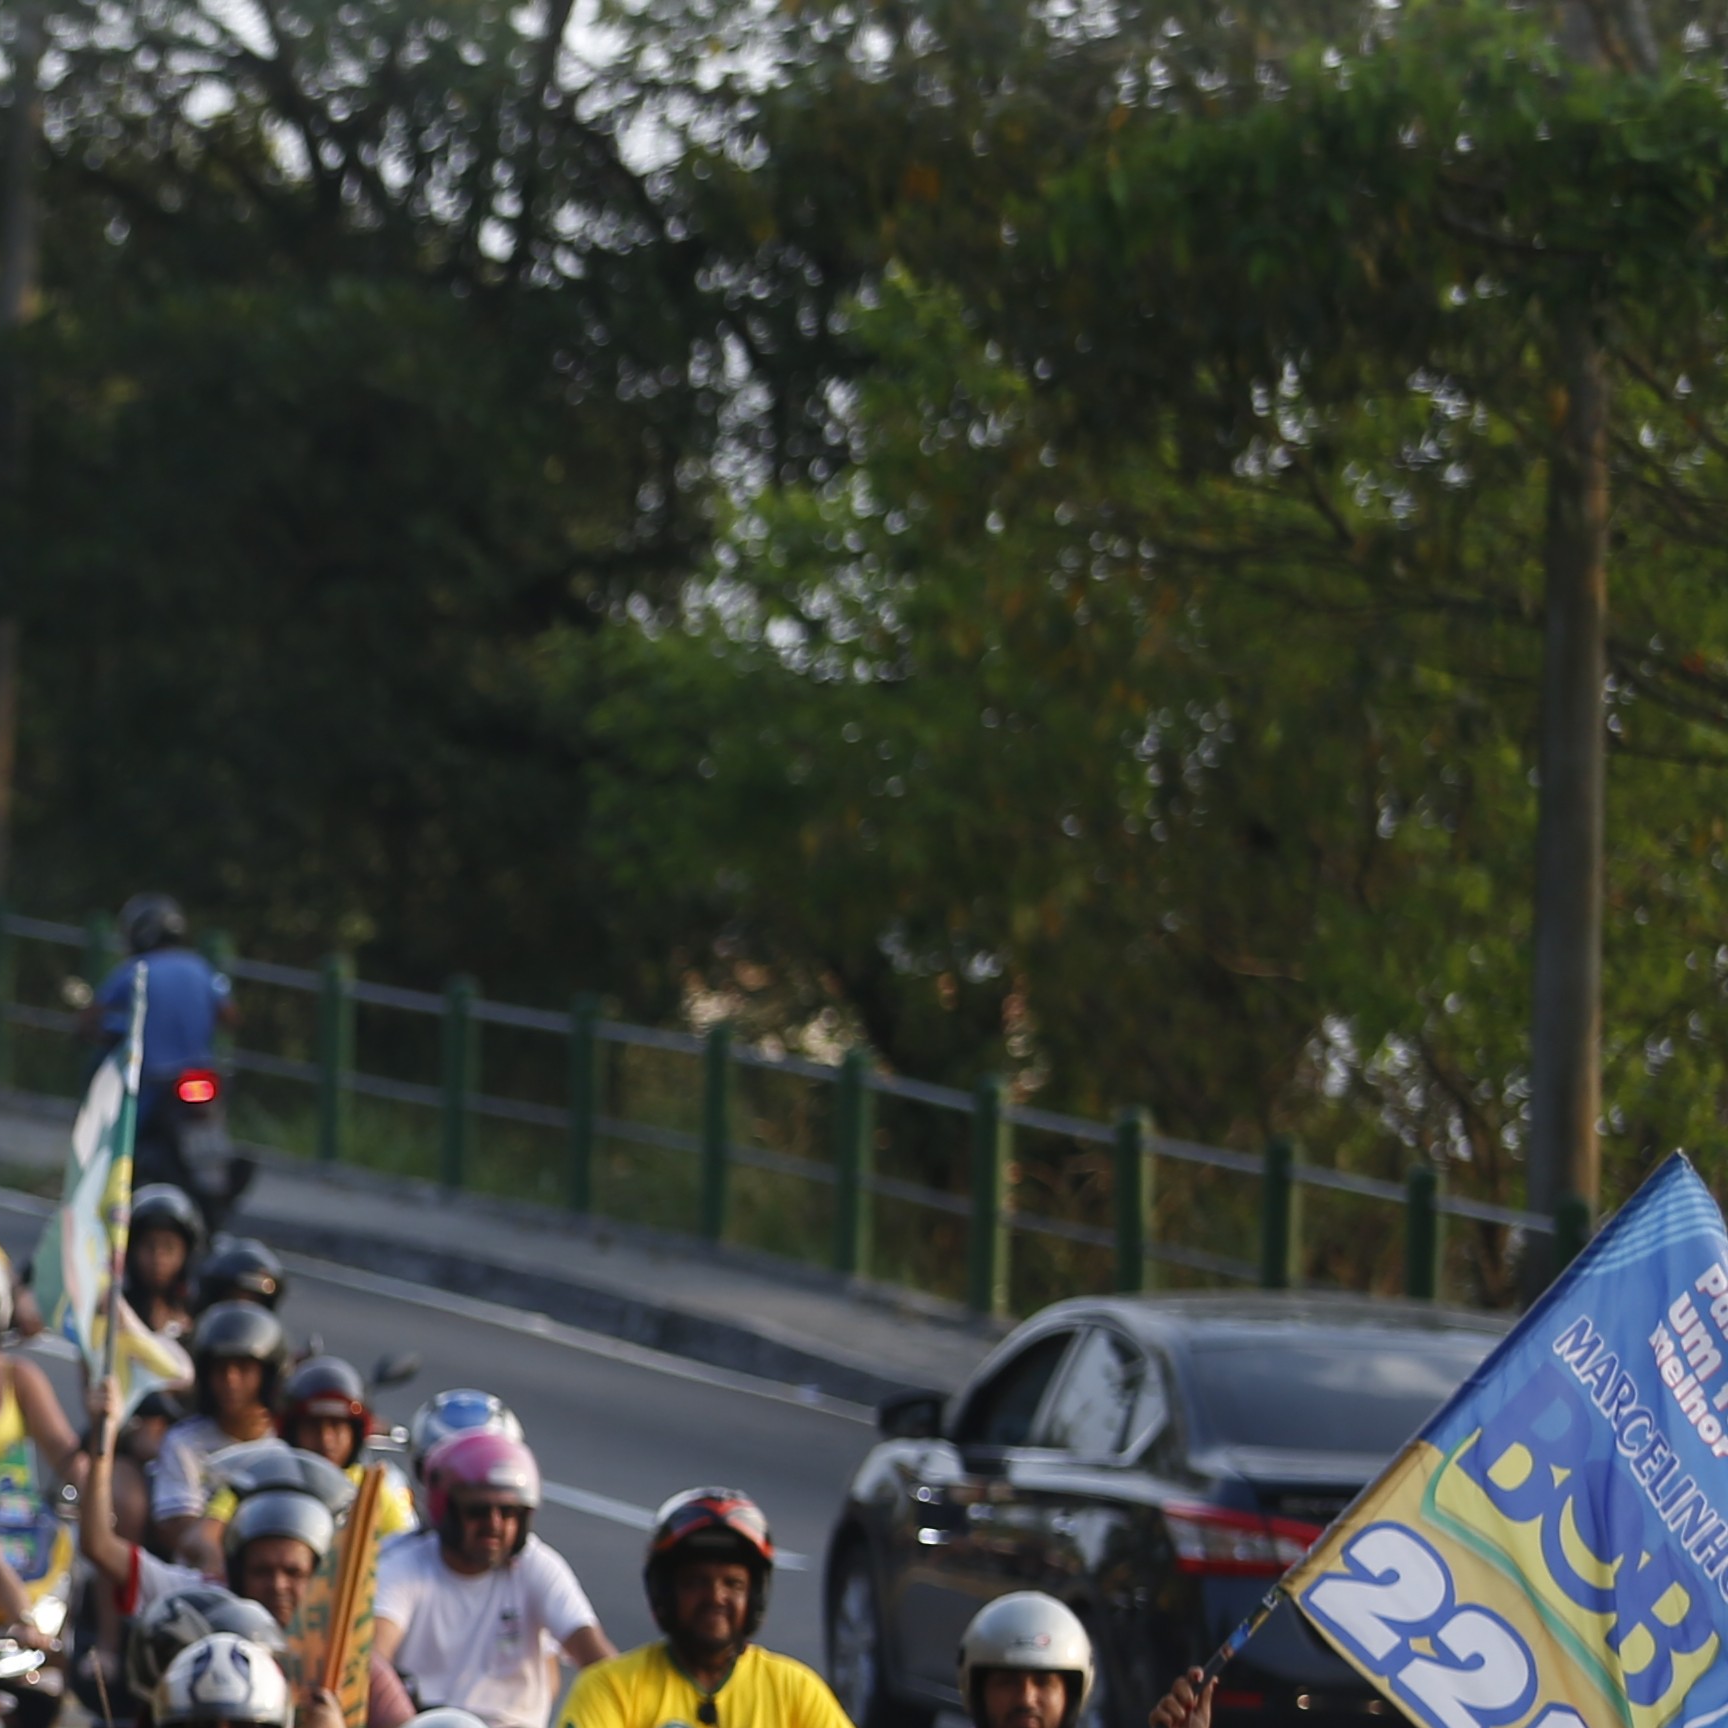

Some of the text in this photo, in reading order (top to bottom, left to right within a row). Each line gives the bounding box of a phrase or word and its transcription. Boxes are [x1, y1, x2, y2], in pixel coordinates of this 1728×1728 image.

[1668, 1290, 1723, 1384] um
[1694, 1262, 1728, 1342] Pa
[1648, 1319, 1728, 1459] melhor
[1552, 1314, 1728, 1606] MARCELINH
